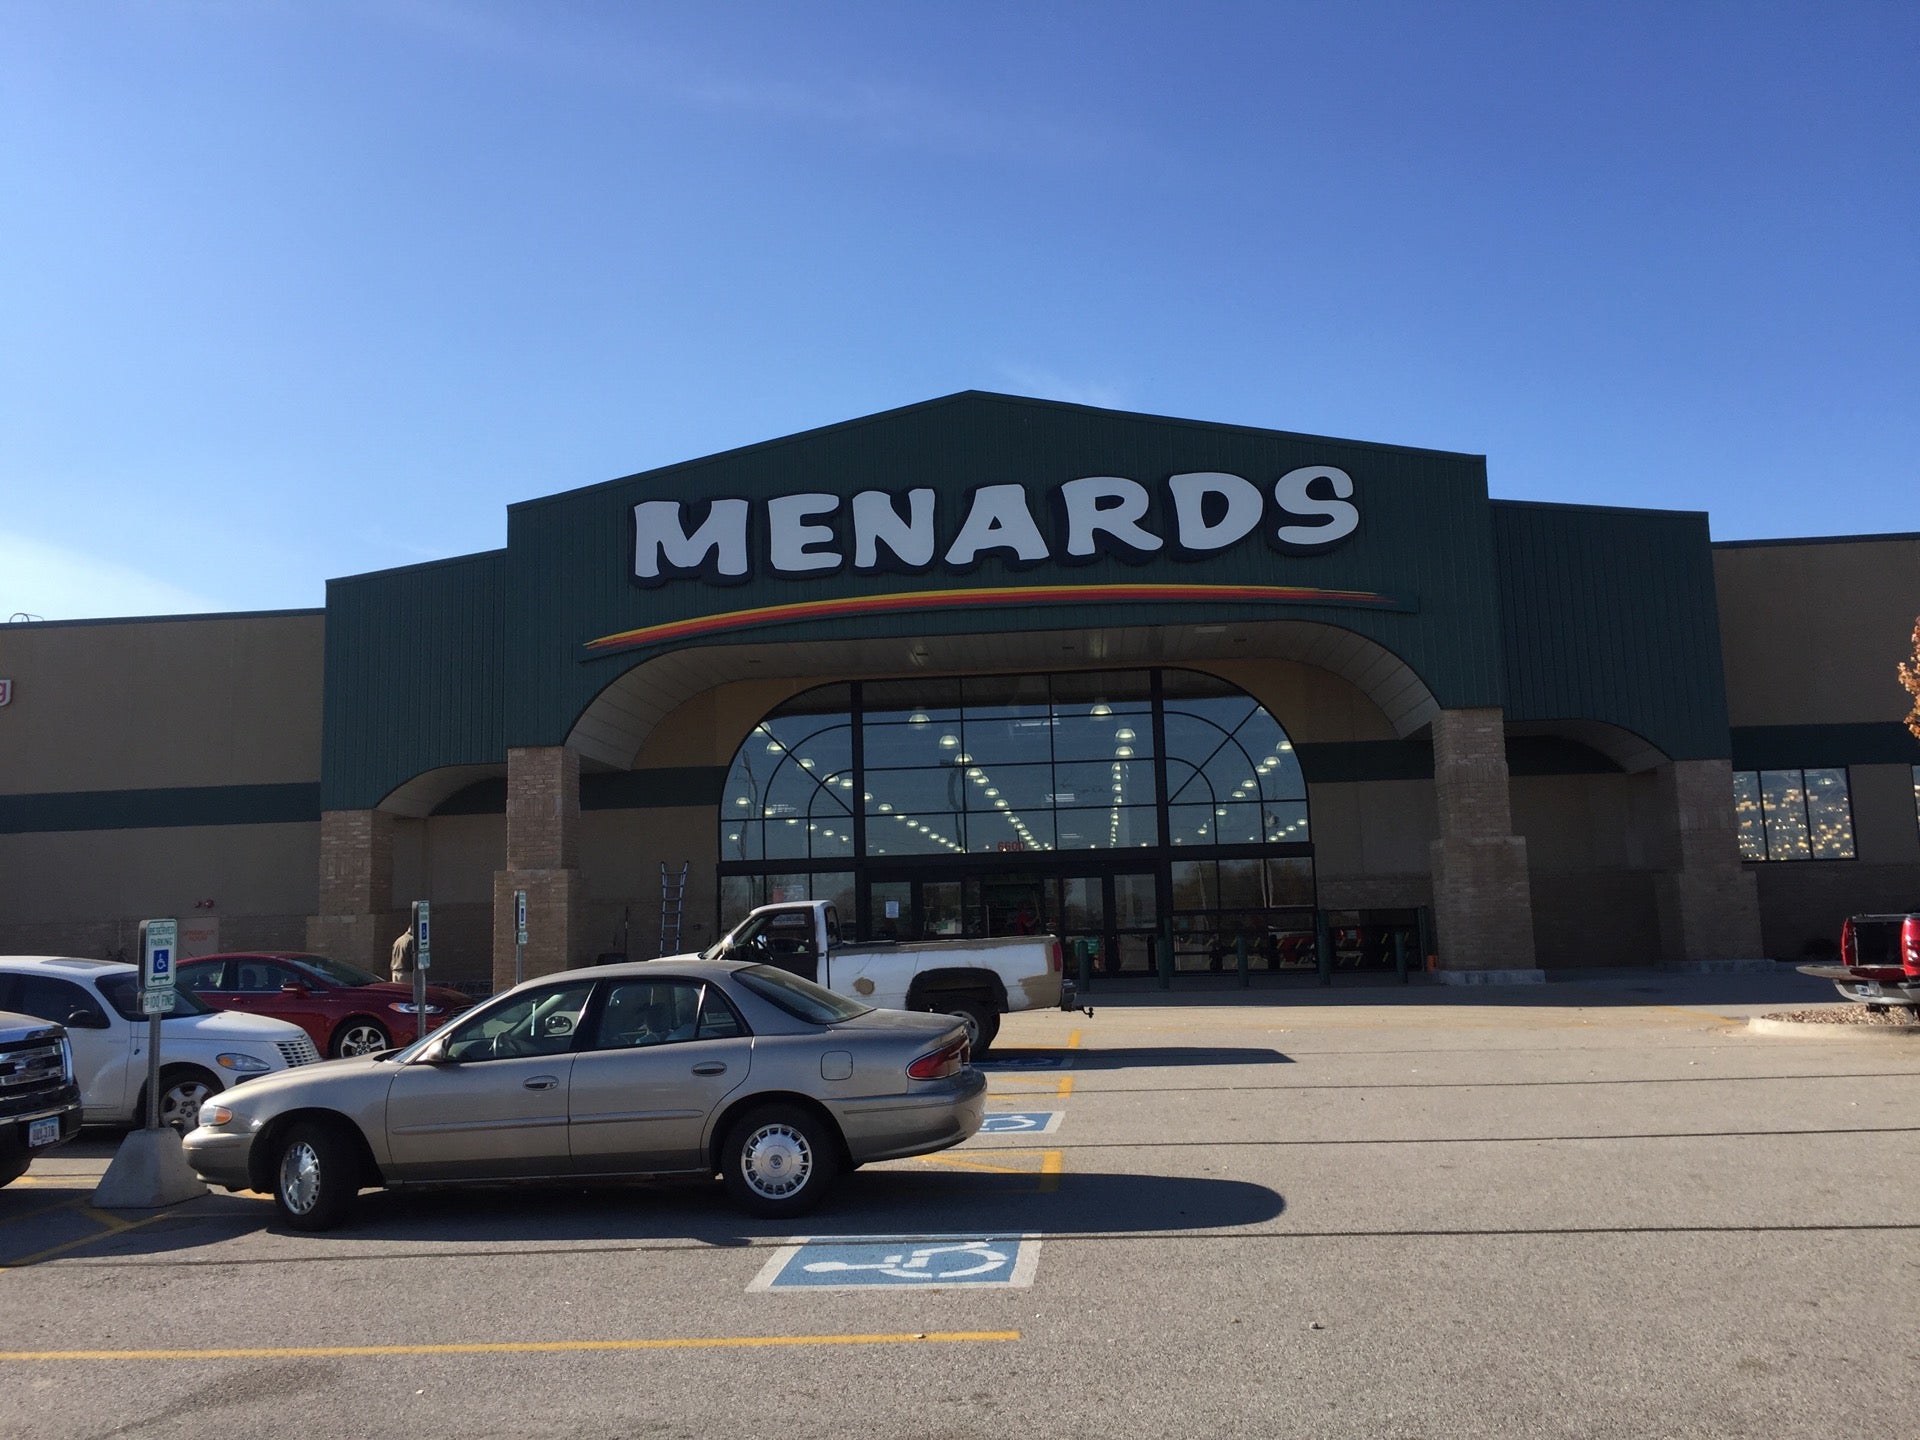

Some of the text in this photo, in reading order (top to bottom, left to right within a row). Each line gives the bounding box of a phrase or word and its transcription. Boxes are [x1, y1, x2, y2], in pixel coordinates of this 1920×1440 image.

[631, 464, 1361, 579] MENARDS
[148, 926, 175, 935] RESERVED
[150, 938, 173, 946] PARKING
[161, 993, 175, 1006] FINE
